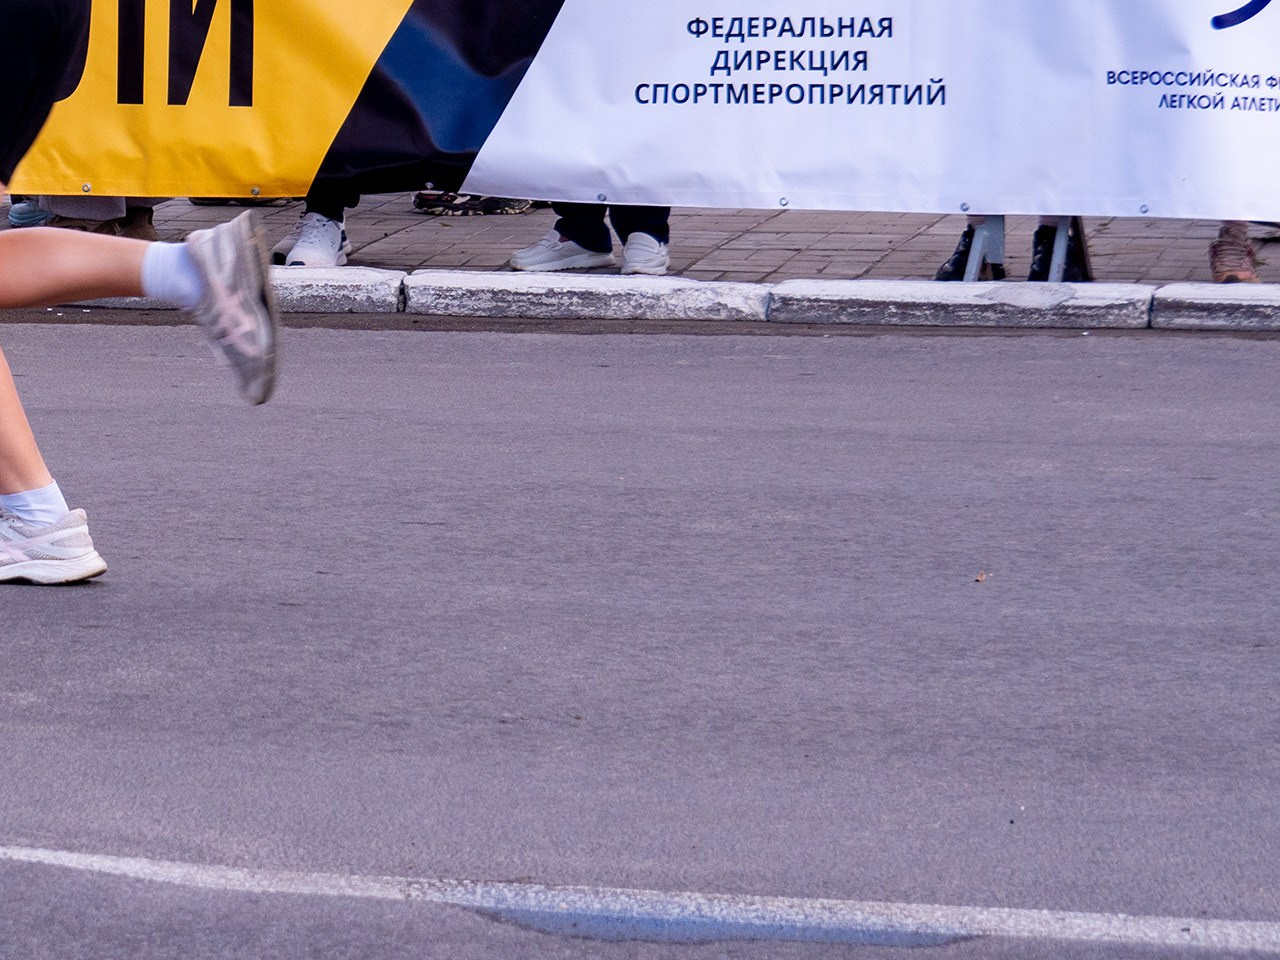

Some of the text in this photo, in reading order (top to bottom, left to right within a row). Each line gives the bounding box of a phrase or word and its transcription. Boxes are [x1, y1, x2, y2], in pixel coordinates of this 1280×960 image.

[686, 16, 894, 44] ФЕДЕРАЛЬНАЯ
[710, 50, 869, 77] ДИРЕКЦИЯ
[634, 78, 947, 106] СПОРТМЕРОПРИЯТИЙ
[1106, 69, 1280, 90] ВСЕРОССИЙСКАЯ Ф
[1158, 92, 1226, 110] ЛЕГКОЙ
